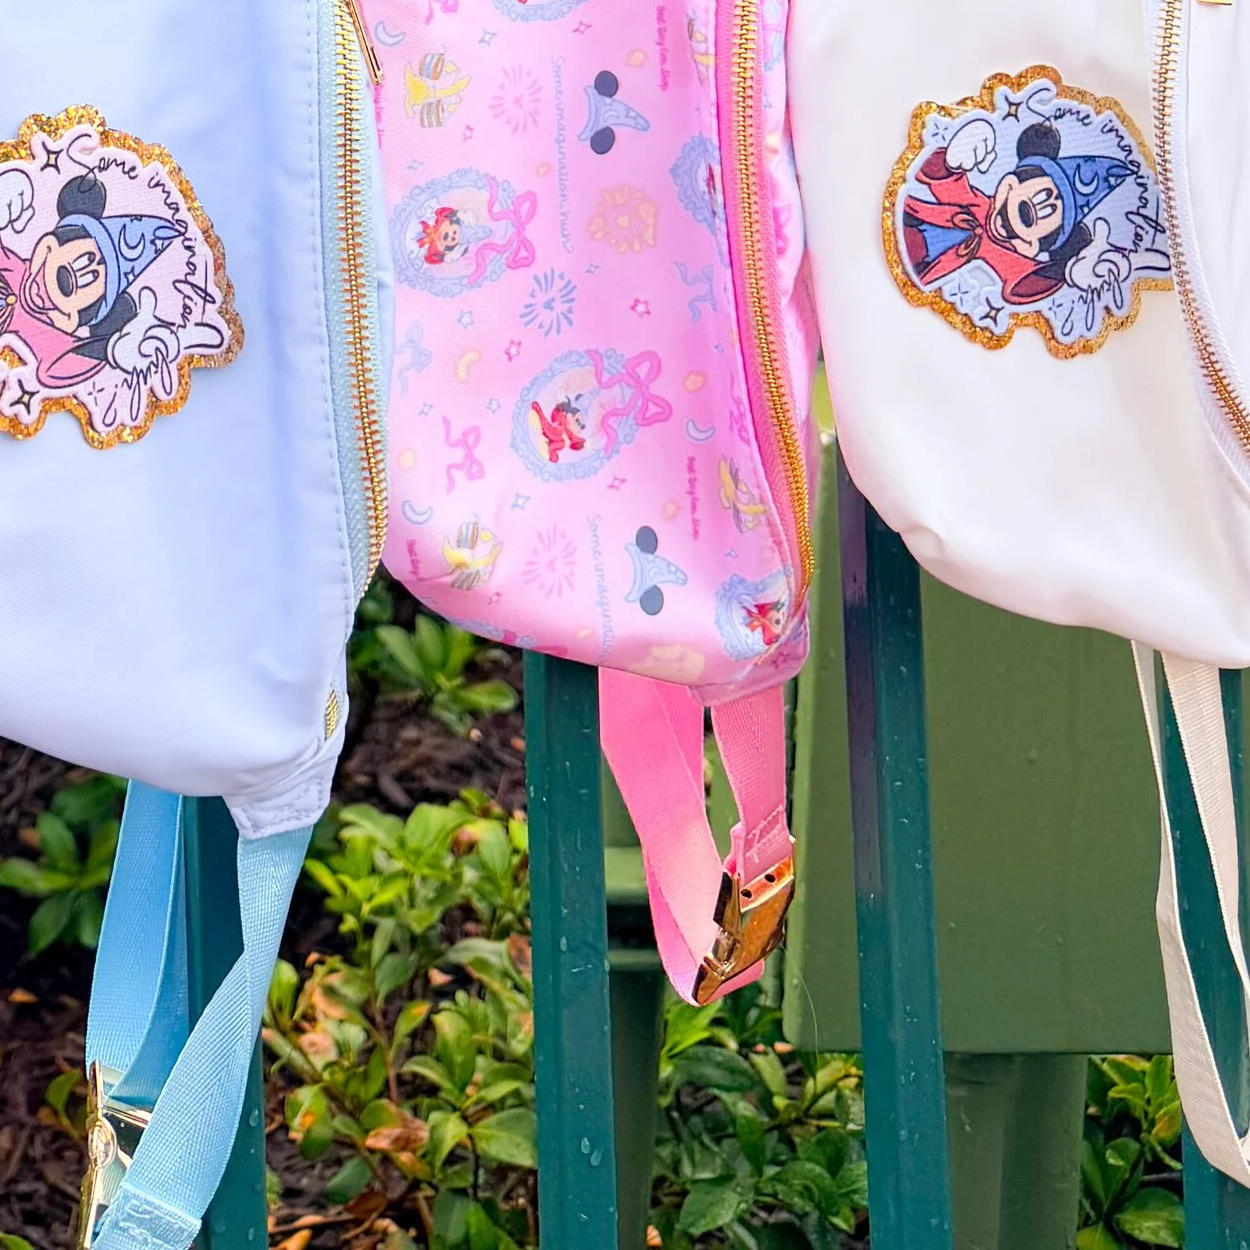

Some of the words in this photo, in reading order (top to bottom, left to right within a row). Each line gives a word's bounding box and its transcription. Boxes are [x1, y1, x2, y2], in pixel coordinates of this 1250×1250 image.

[550, 55, 566, 100] Some
[1025, 87, 1093, 126] Some
[66, 133, 139, 193] Some
